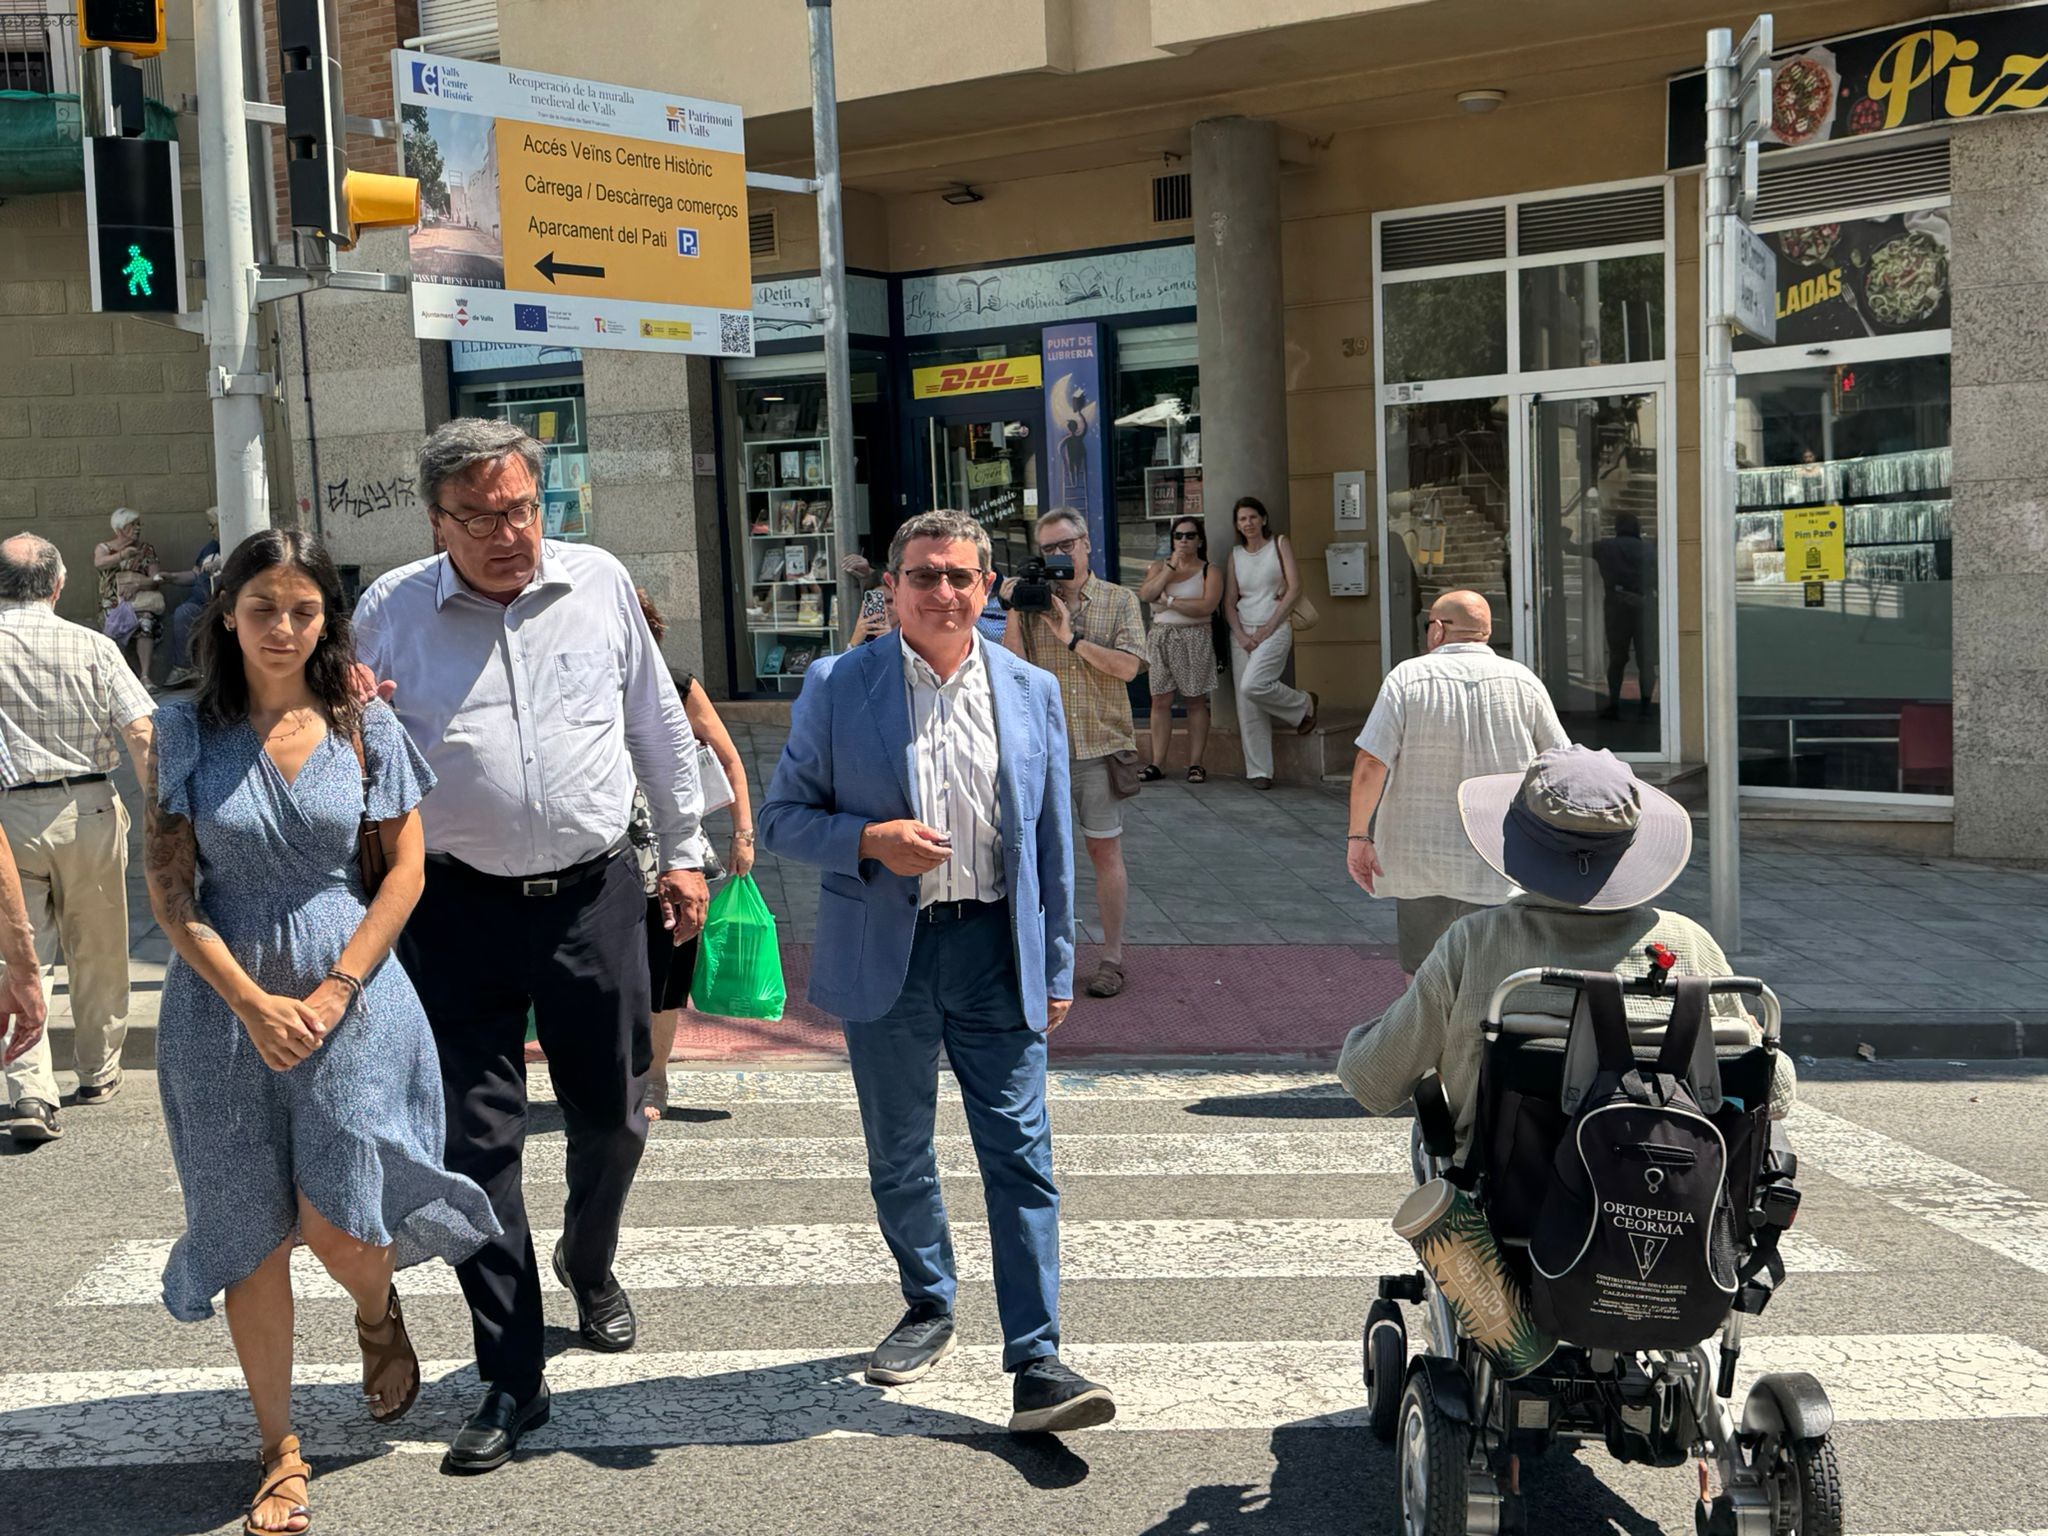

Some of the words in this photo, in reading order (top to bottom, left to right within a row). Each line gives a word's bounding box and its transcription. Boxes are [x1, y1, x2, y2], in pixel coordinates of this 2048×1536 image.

[441, 66, 460, 78] Valls
[442, 78, 468, 90] Centre
[508, 72, 571, 95] Recuperació
[573, 83, 586, 96] de
[587, 85, 597, 98] la
[599, 88, 635, 105] muralla
[442, 89, 474, 102] Històric
[530, 94, 575, 111] medieval
[577, 100, 591, 113] de
[592, 101, 616, 116] Valls
[688, 109, 733, 127] Patrimoni
[689, 124, 710, 137] Valls
[523, 135, 567, 157] Accés
[571, 140, 612, 163] Veïns
[616, 148, 661, 170] Centre
[665, 154, 713, 177] Històric
[525, 174, 583, 201] Càrrega
[587, 182, 592, 200] /
[596, 184, 673, 214] Descàrrega
[677, 198, 738, 220] comerços
[528, 216, 614, 242] Aparcament
[618, 226, 637, 244] del
[642, 228, 668, 248] Pati
[442, 276, 473, 287] PRESENT
[478, 279, 501, 289] FUTUR
[759, 286, 792, 304] Petit
[421, 311, 453, 319] Ajuntament
[1048, 337, 1075, 349] PUNT
[1078, 336, 1093, 346] DE
[1342, 337, 1368, 357] 39
[1047, 349, 1094, 361] LLIBRERIA
[940, 363, 1014, 392] DHL
[1794, 531, 1811, 539] Pim
[1603, 1201, 1695, 1223] ORTOPEDIA
[1613, 1216, 1684, 1235] CEORMA
[1603, 1290, 1635, 1299] CALZADO
